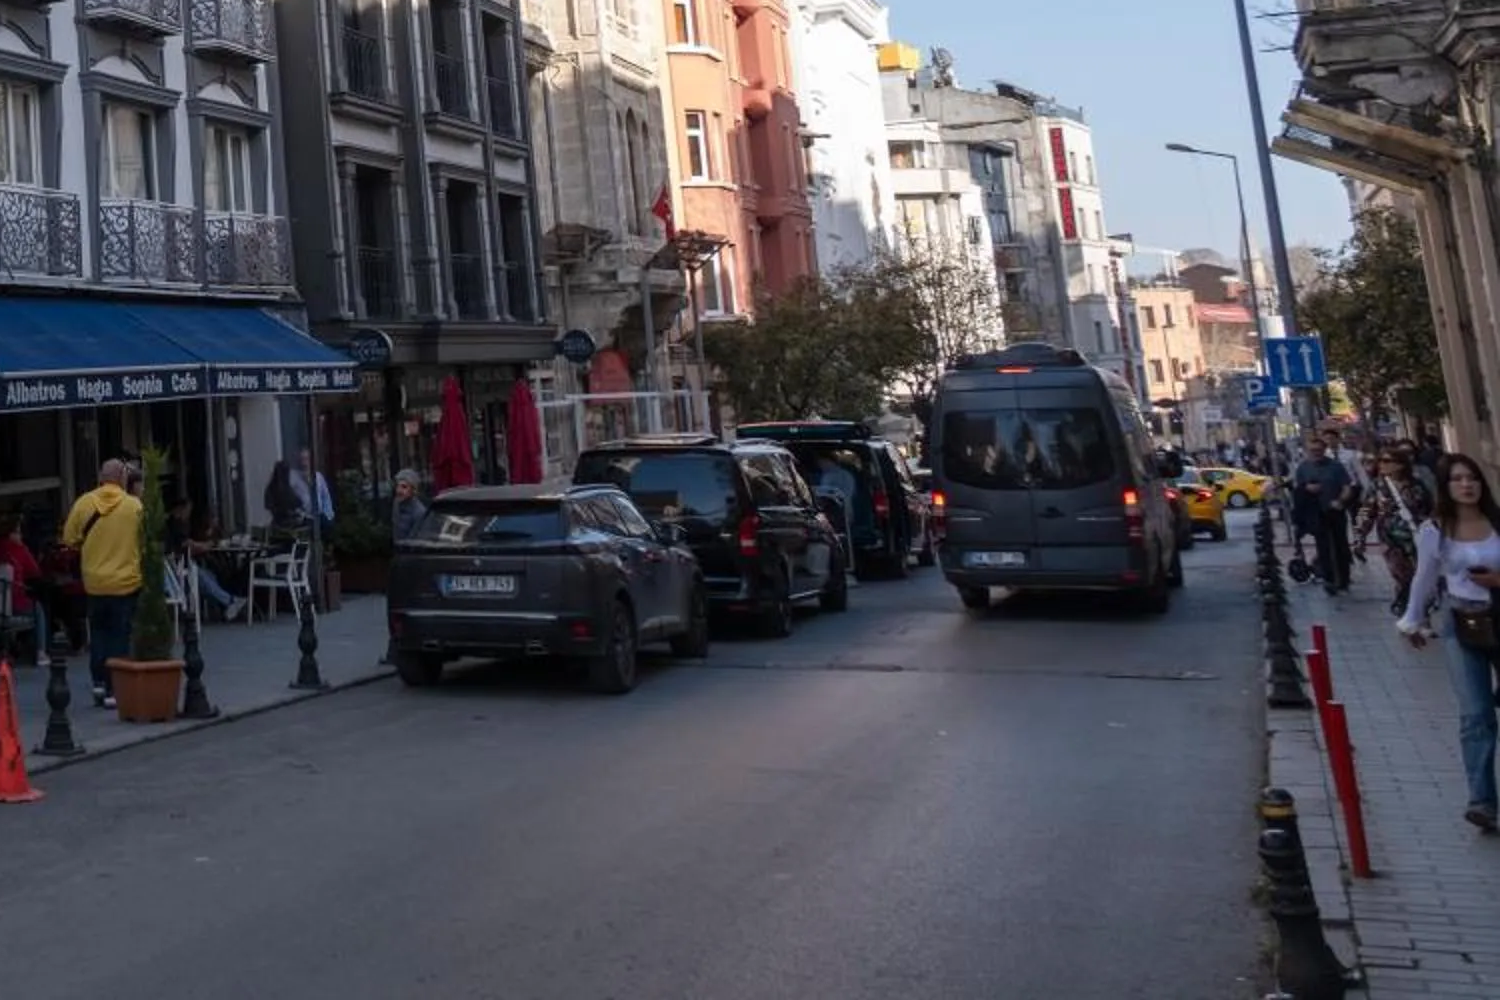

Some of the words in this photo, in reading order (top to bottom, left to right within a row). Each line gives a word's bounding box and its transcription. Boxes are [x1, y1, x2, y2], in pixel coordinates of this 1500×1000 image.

[6, 380, 65, 405] Albatros
[123, 376, 163, 398] Sophia
[171, 373, 197, 392] Cafe
[1245, 379, 1264, 402] P
